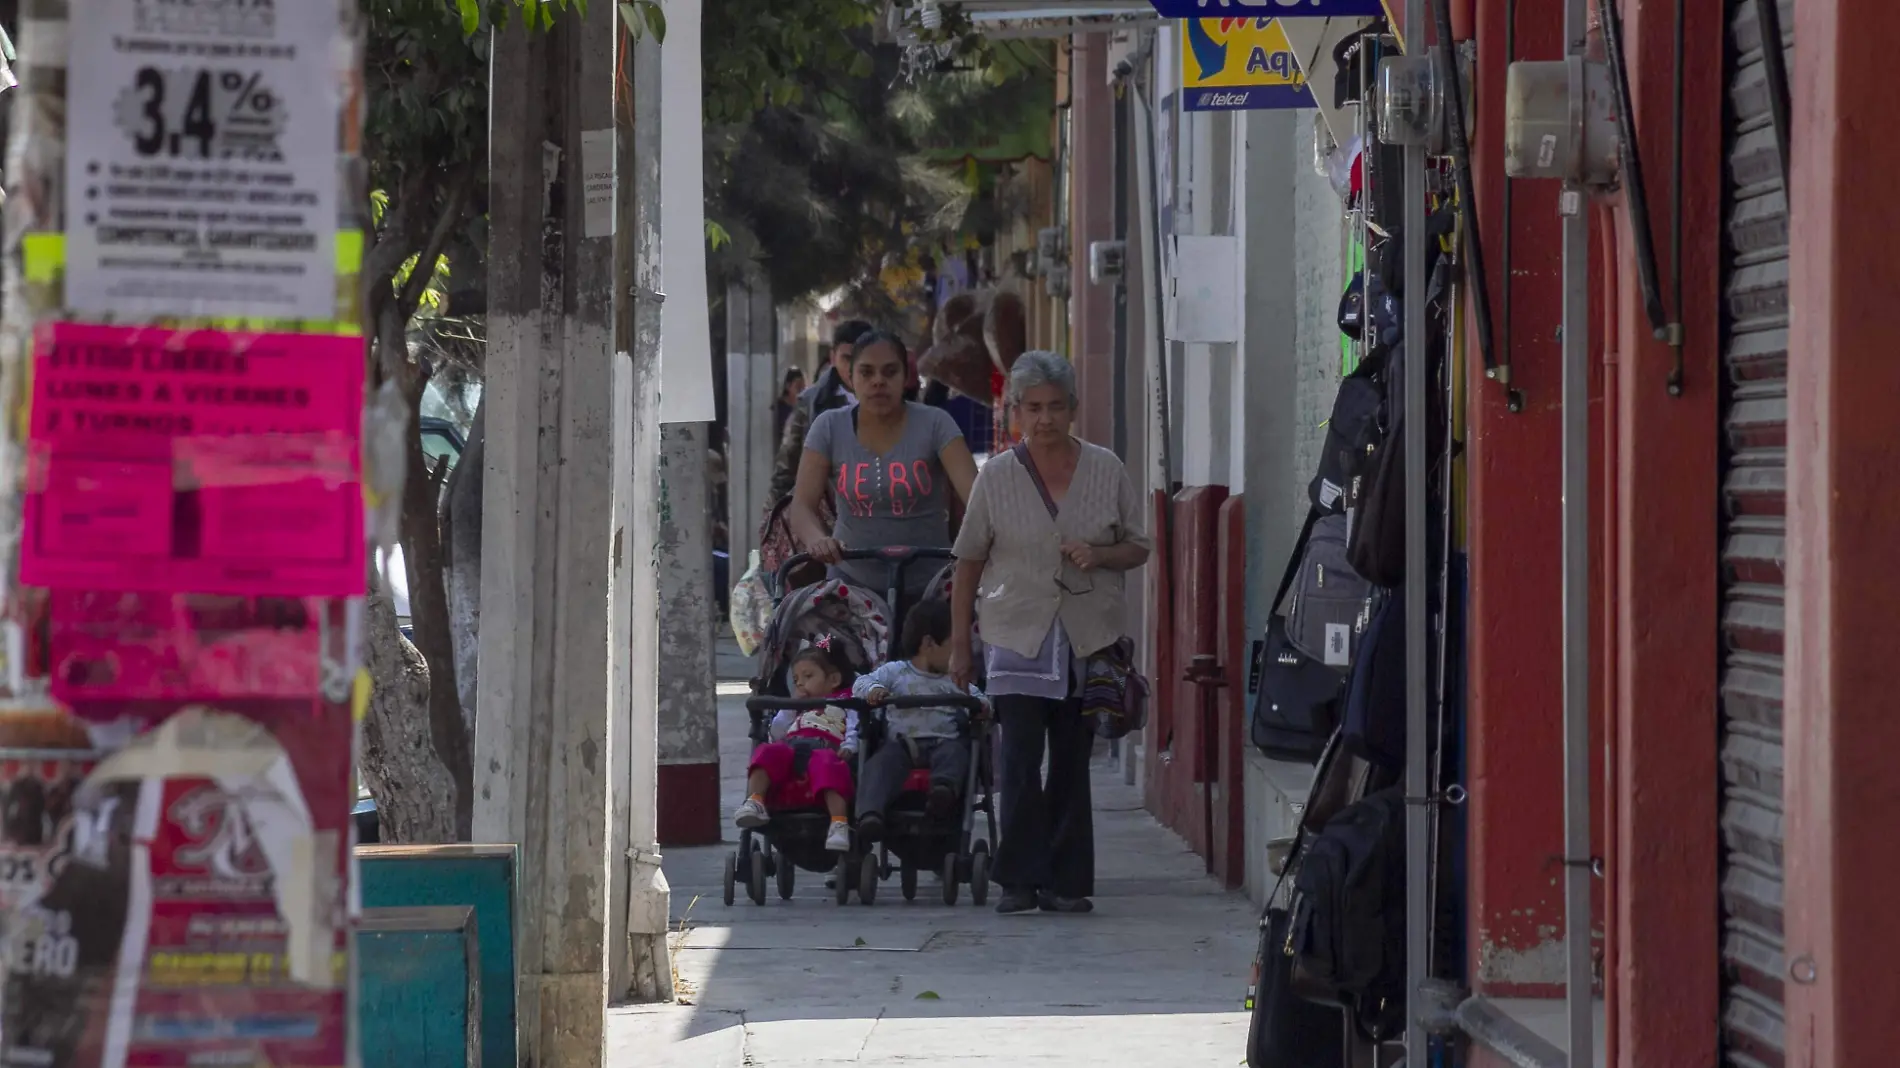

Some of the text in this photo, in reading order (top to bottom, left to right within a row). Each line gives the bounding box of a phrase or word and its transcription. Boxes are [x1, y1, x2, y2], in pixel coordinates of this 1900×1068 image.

[1246, 46, 1302, 80] Aqu
[134, 67, 274, 158] 3.4%
[1210, 91, 1249, 106] telcel
[46, 381, 310, 409] LUNES A VIERNES
[74, 410, 193, 433] TURNOS
